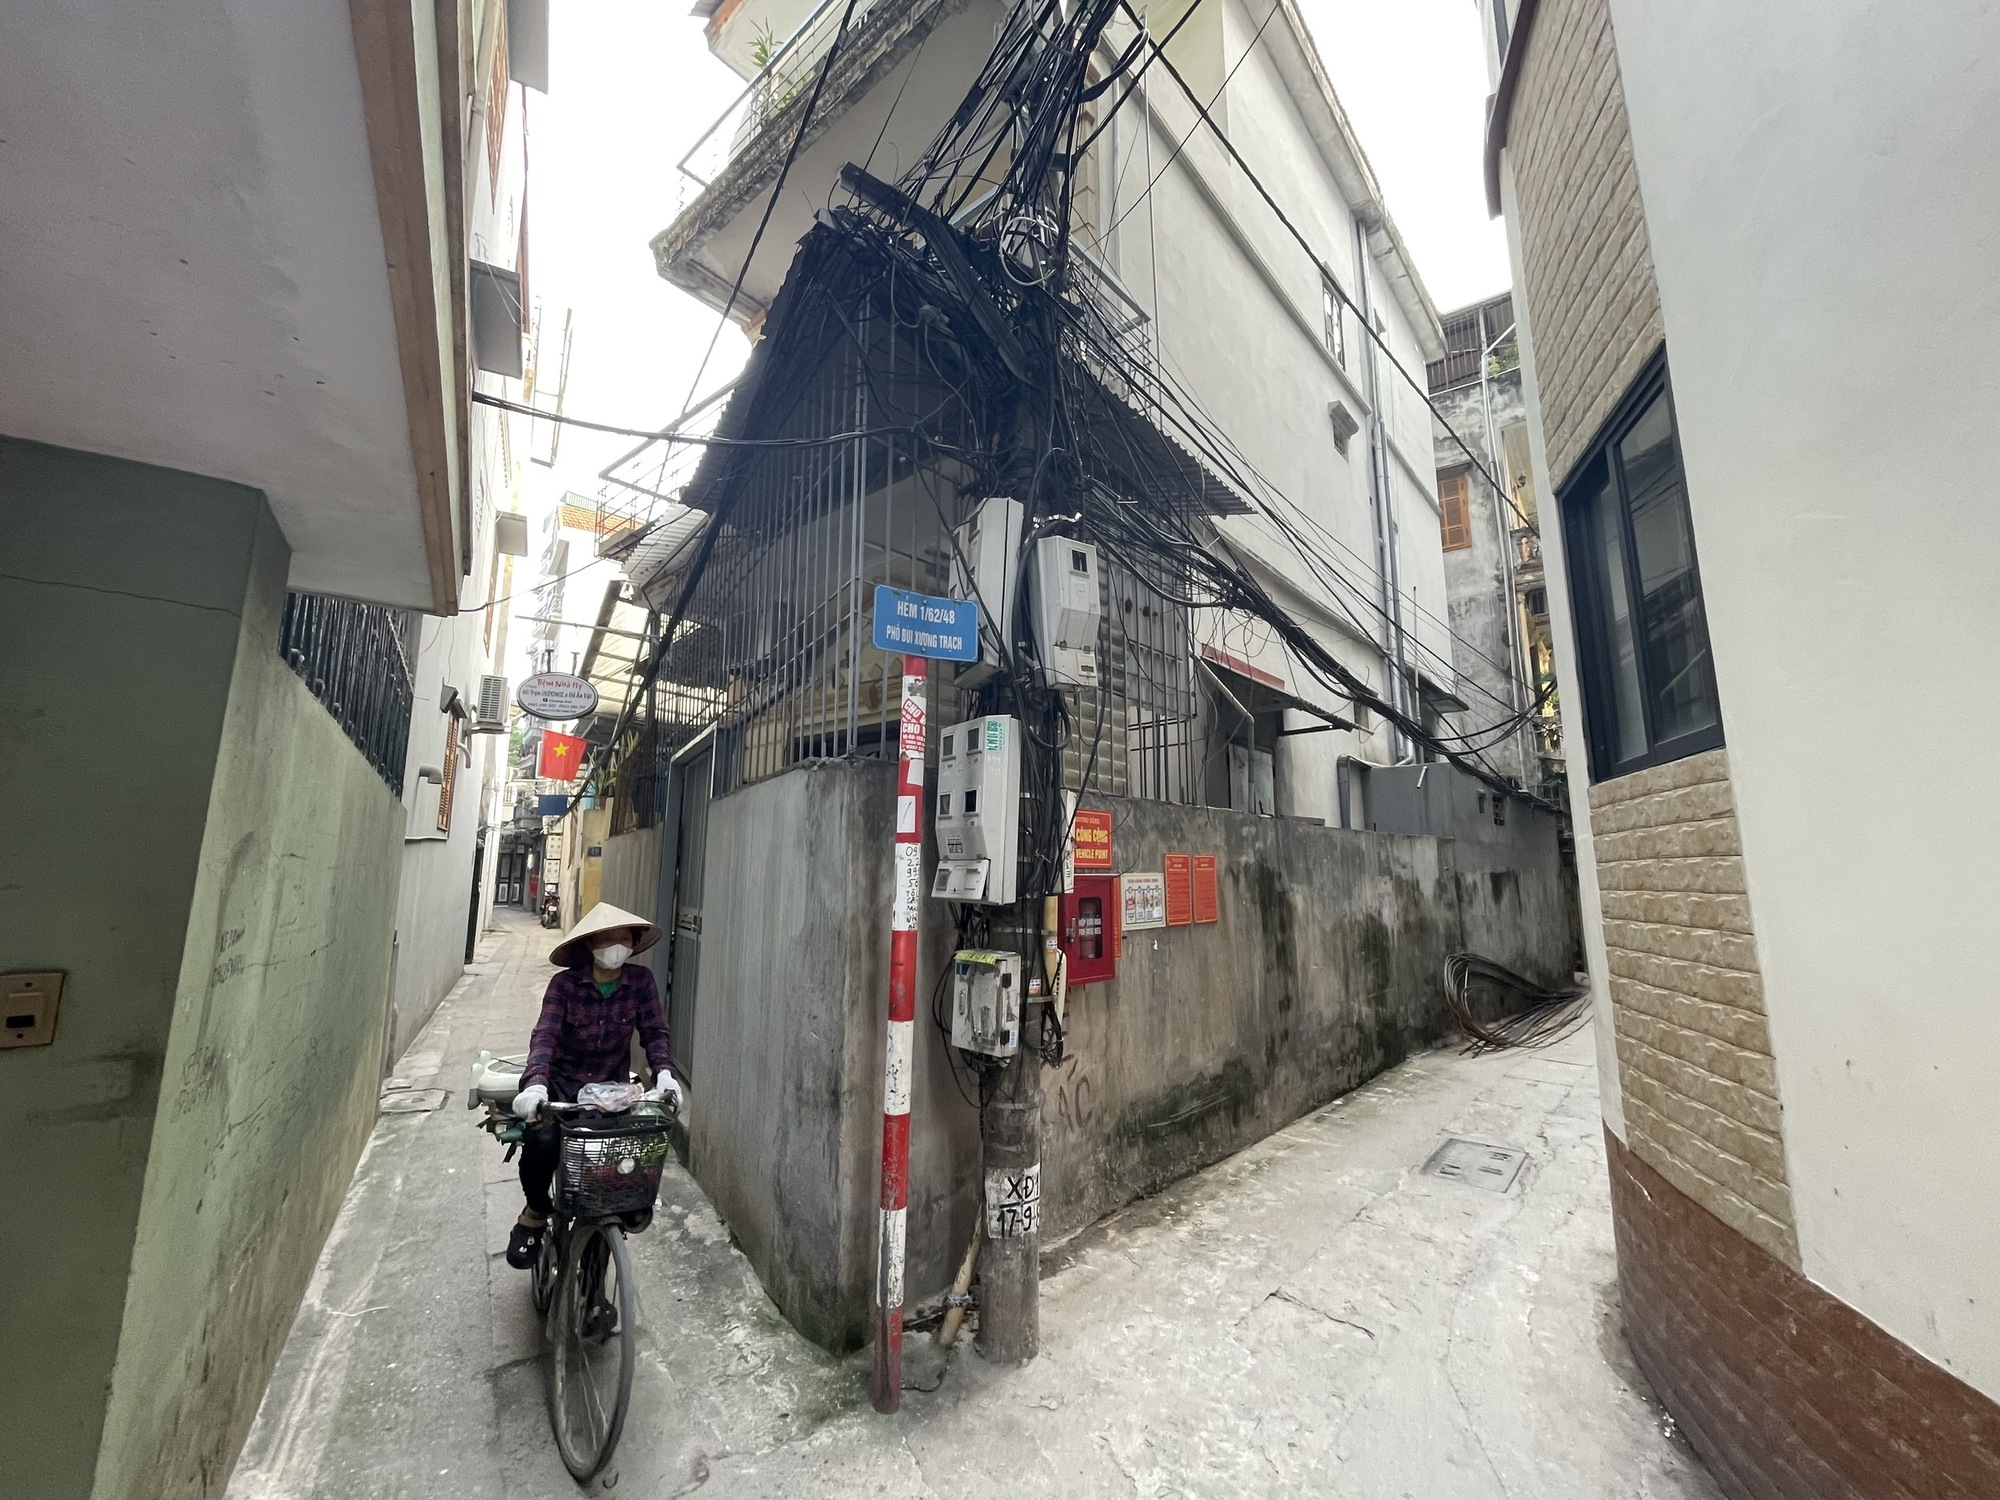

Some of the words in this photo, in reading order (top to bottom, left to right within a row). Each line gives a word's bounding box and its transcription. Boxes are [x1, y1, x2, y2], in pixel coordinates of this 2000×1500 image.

[897, 596, 917, 618] HẺM
[920, 606, 955, 624] 1/62/48
[886, 621, 900, 641] PHỐ
[902, 625, 913, 643] BÙI
[914, 631, 937, 648] XƯƠNG
[939, 635, 962, 652] TRẠCH
[904, 700, 922, 718] CHO
[902, 722, 920, 734] CHO
[1076, 826, 1092, 842] CÔNG
[1093, 827, 1108, 845] CỘNG
[906, 846, 917, 857] 09
[1075, 849, 1095, 858] VEHICLE
